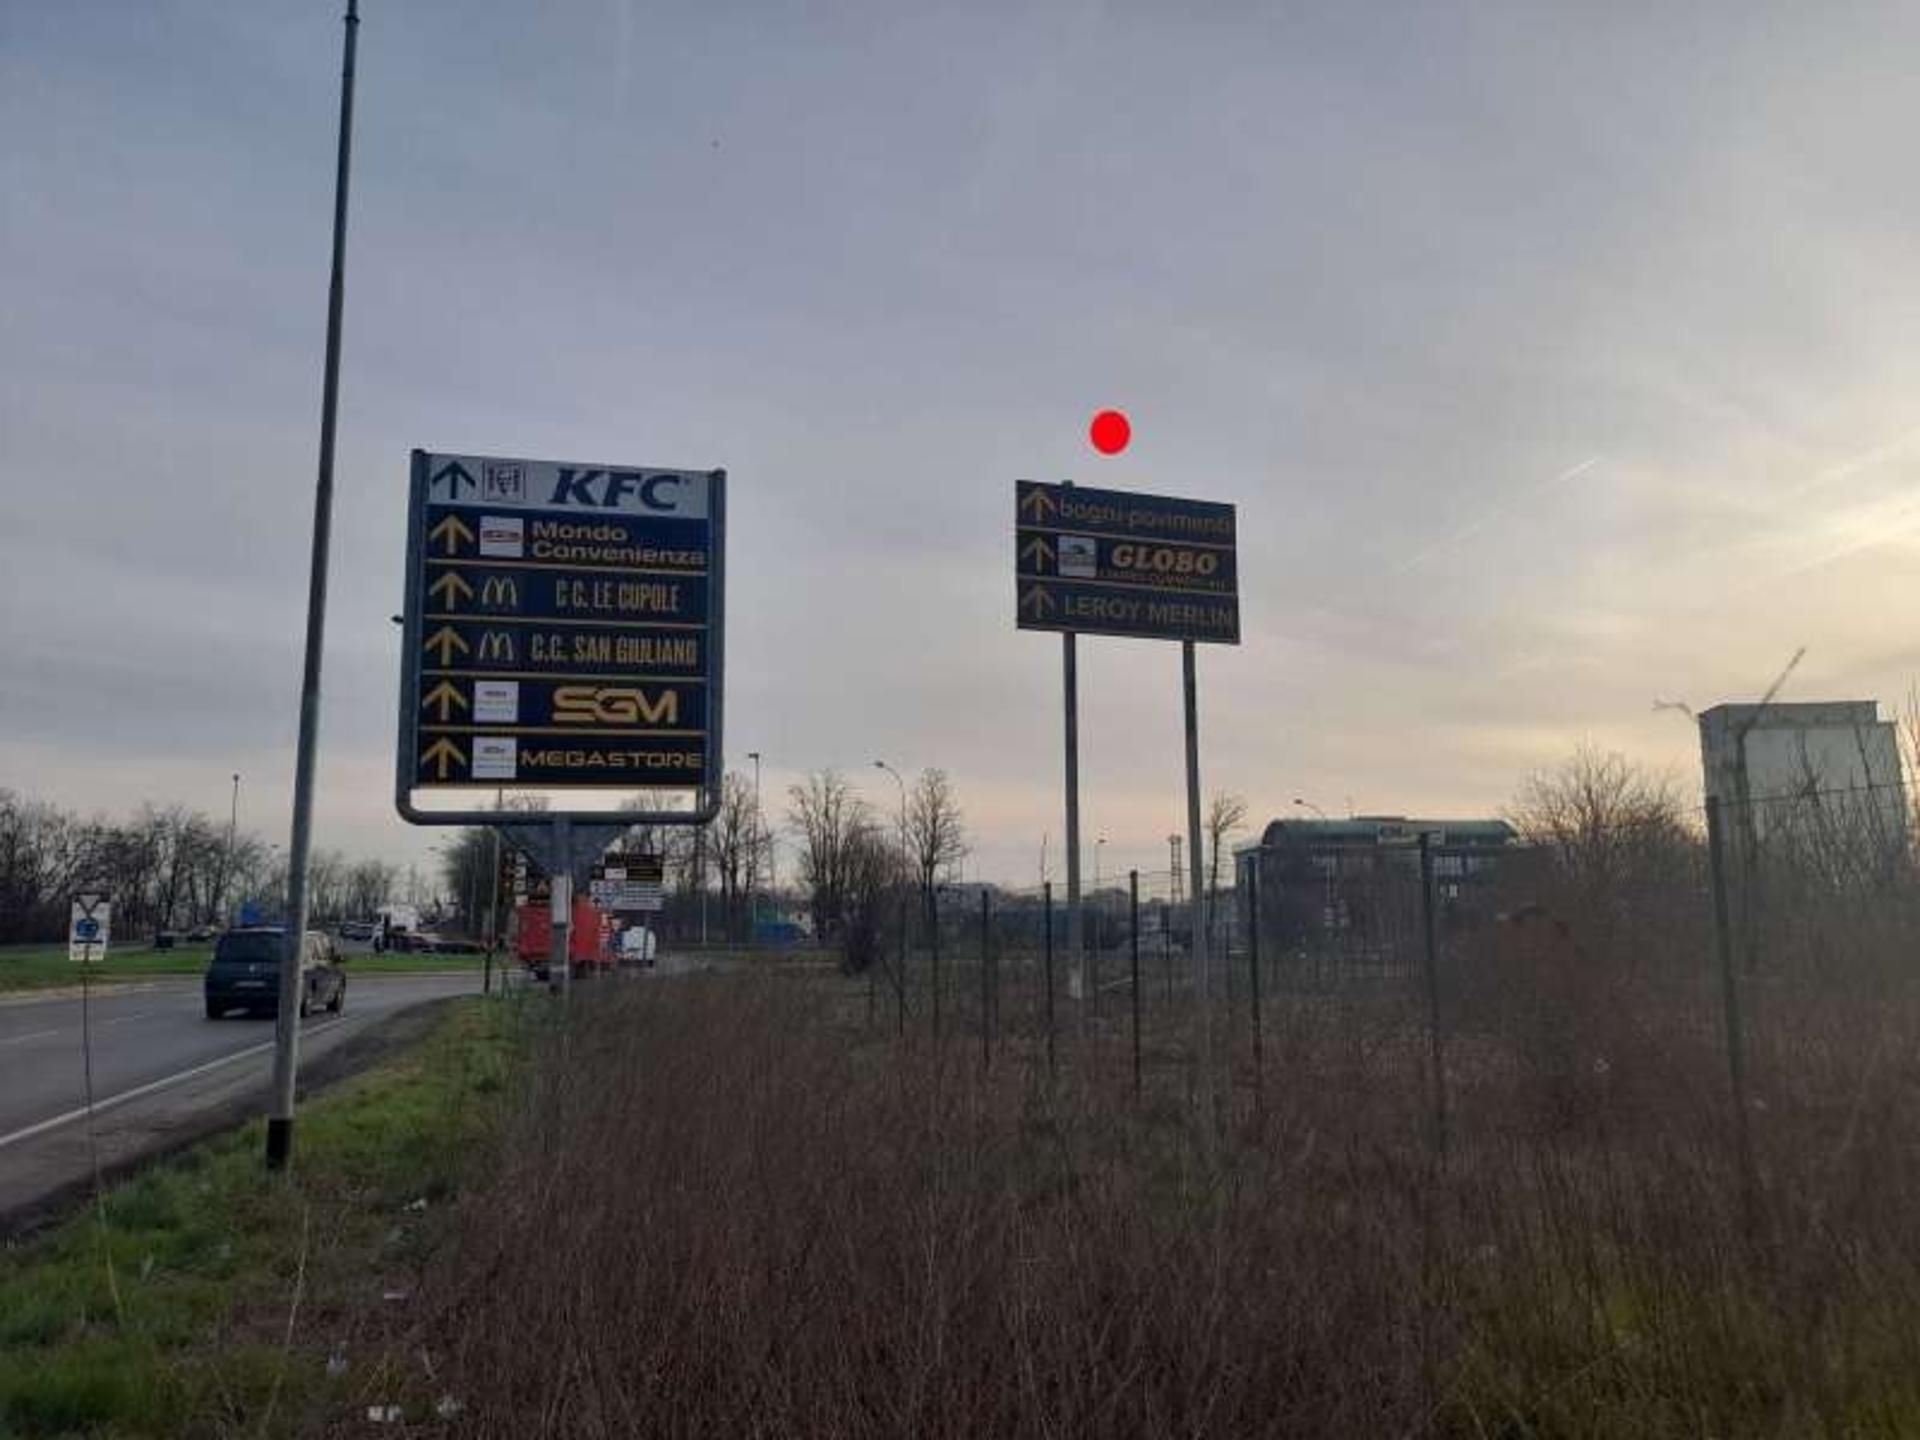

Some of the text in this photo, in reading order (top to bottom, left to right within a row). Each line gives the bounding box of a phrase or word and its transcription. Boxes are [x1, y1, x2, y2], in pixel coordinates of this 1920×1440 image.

[549, 468, 681, 511] KFC
[532, 520, 628, 541] Mondo
[532, 540, 705, 565] Convenienza
[1111, 543, 1218, 575] GLOBO
[594, 582, 614, 609] LE
[618, 582, 680, 612] CUPOLE
[1064, 594, 1233, 626] LEROY MERLIN
[575, 636, 610, 663] SAN
[616, 636, 697, 667] GIULIANO
[552, 685, 678, 724] SGM
[520, 749, 704, 769] MEGASTORE
